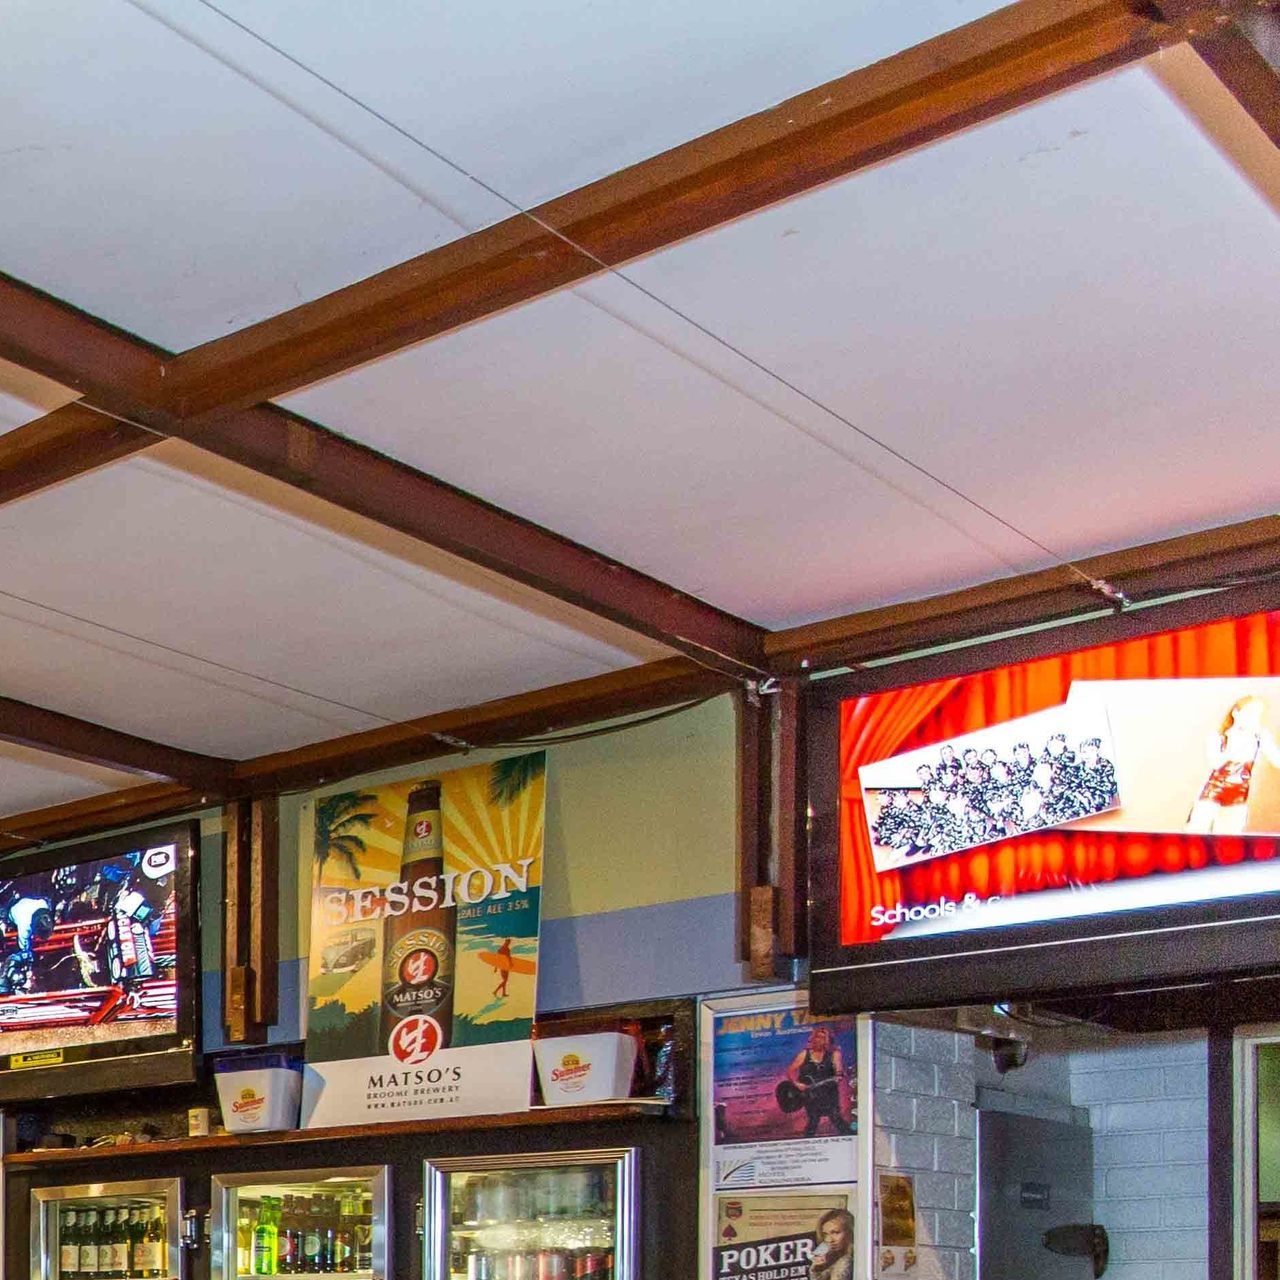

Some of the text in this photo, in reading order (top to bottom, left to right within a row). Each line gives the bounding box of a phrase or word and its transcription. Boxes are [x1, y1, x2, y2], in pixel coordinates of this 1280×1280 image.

[324, 857, 534, 925] SESSION
[487, 904, 502, 914] ALE
[871, 896, 956, 926] Schools
[393, 987, 442, 1003] MATSO'S
[719, 1014, 783, 1035] JENNY
[368, 1066, 462, 1089] MATSO'S
[367, 1086, 460, 1100] BROOME BREWERY
[720, 1238, 815, 1273] POKER
